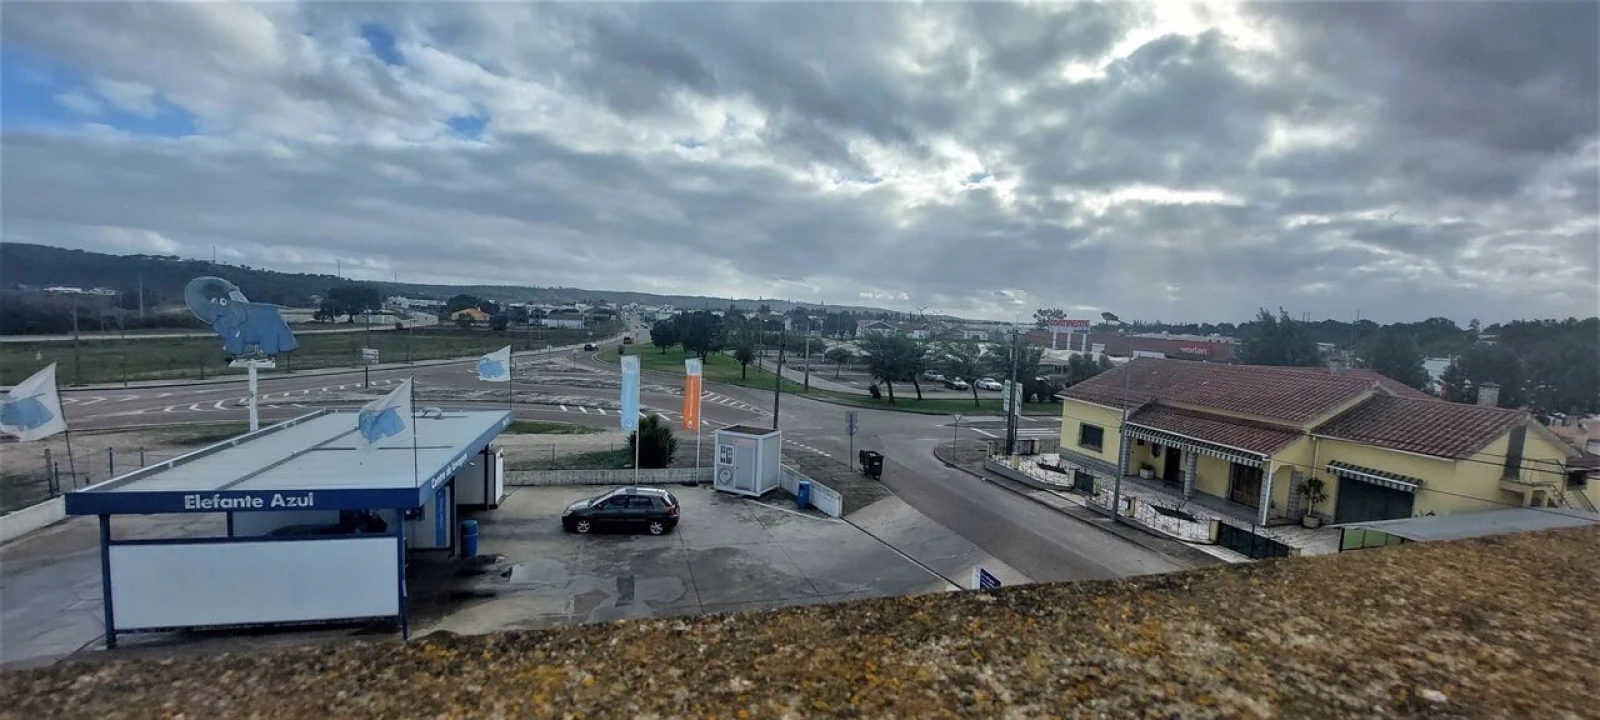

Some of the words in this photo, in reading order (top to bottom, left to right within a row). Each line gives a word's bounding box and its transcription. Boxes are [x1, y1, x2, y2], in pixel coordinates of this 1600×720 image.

[1180, 346, 1207, 355] worten
[184, 494, 264, 509] Elefante
[270, 492, 314, 507] Azul
